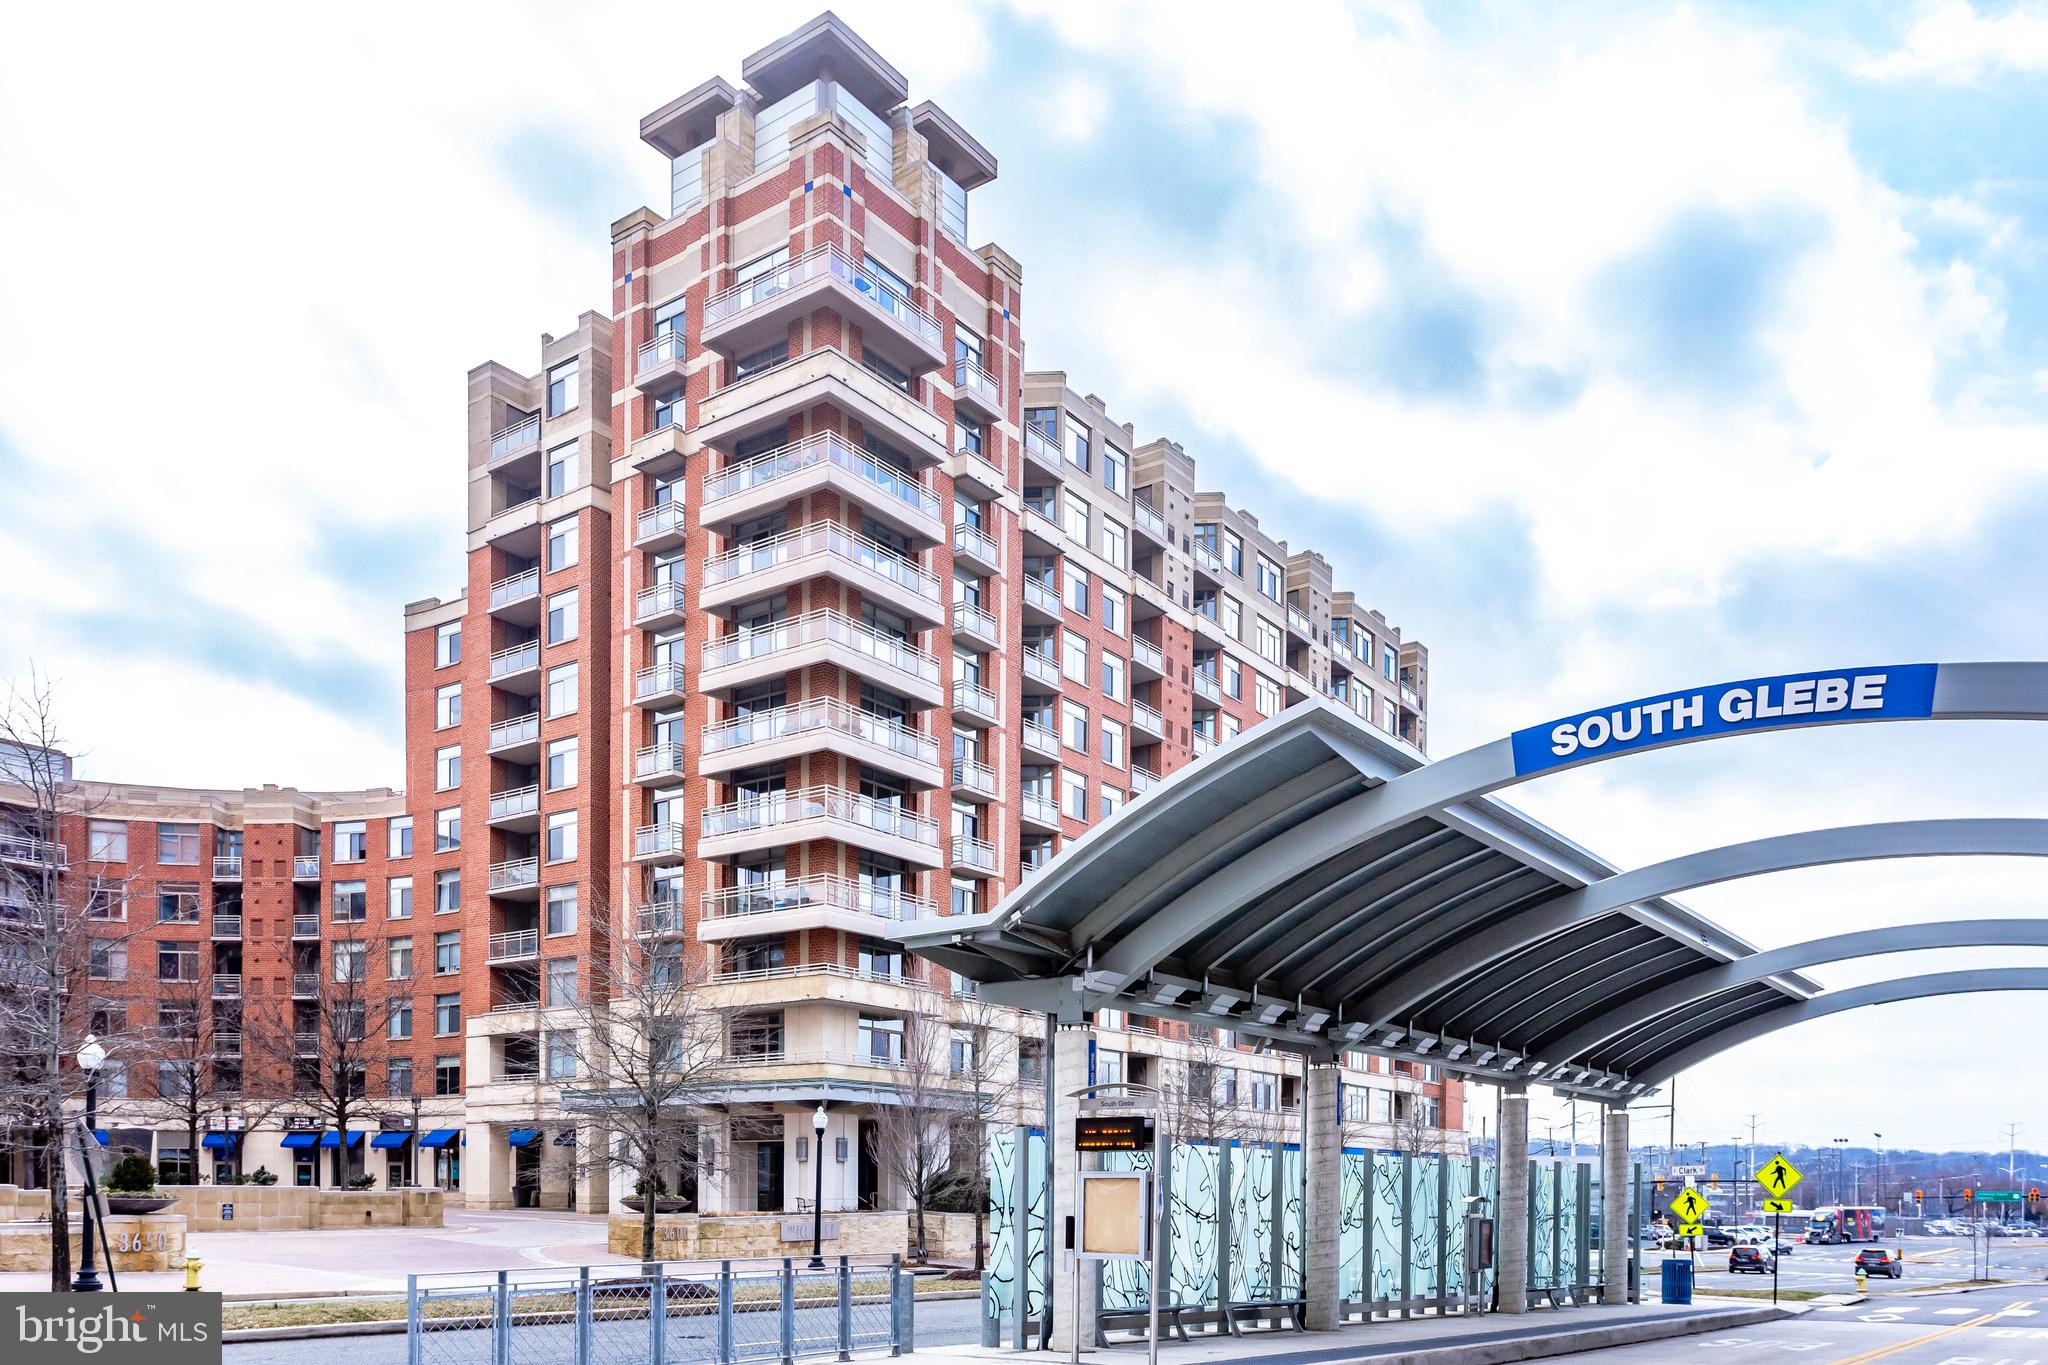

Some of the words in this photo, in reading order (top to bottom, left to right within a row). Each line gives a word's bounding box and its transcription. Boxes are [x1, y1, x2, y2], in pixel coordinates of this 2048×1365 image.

[1551, 694, 1703, 757] SOUTH
[1718, 674, 1887, 723] GLEBE
[1678, 1166, 1698, 1175] Clark
[119, 1231, 167, 1253] 3650
